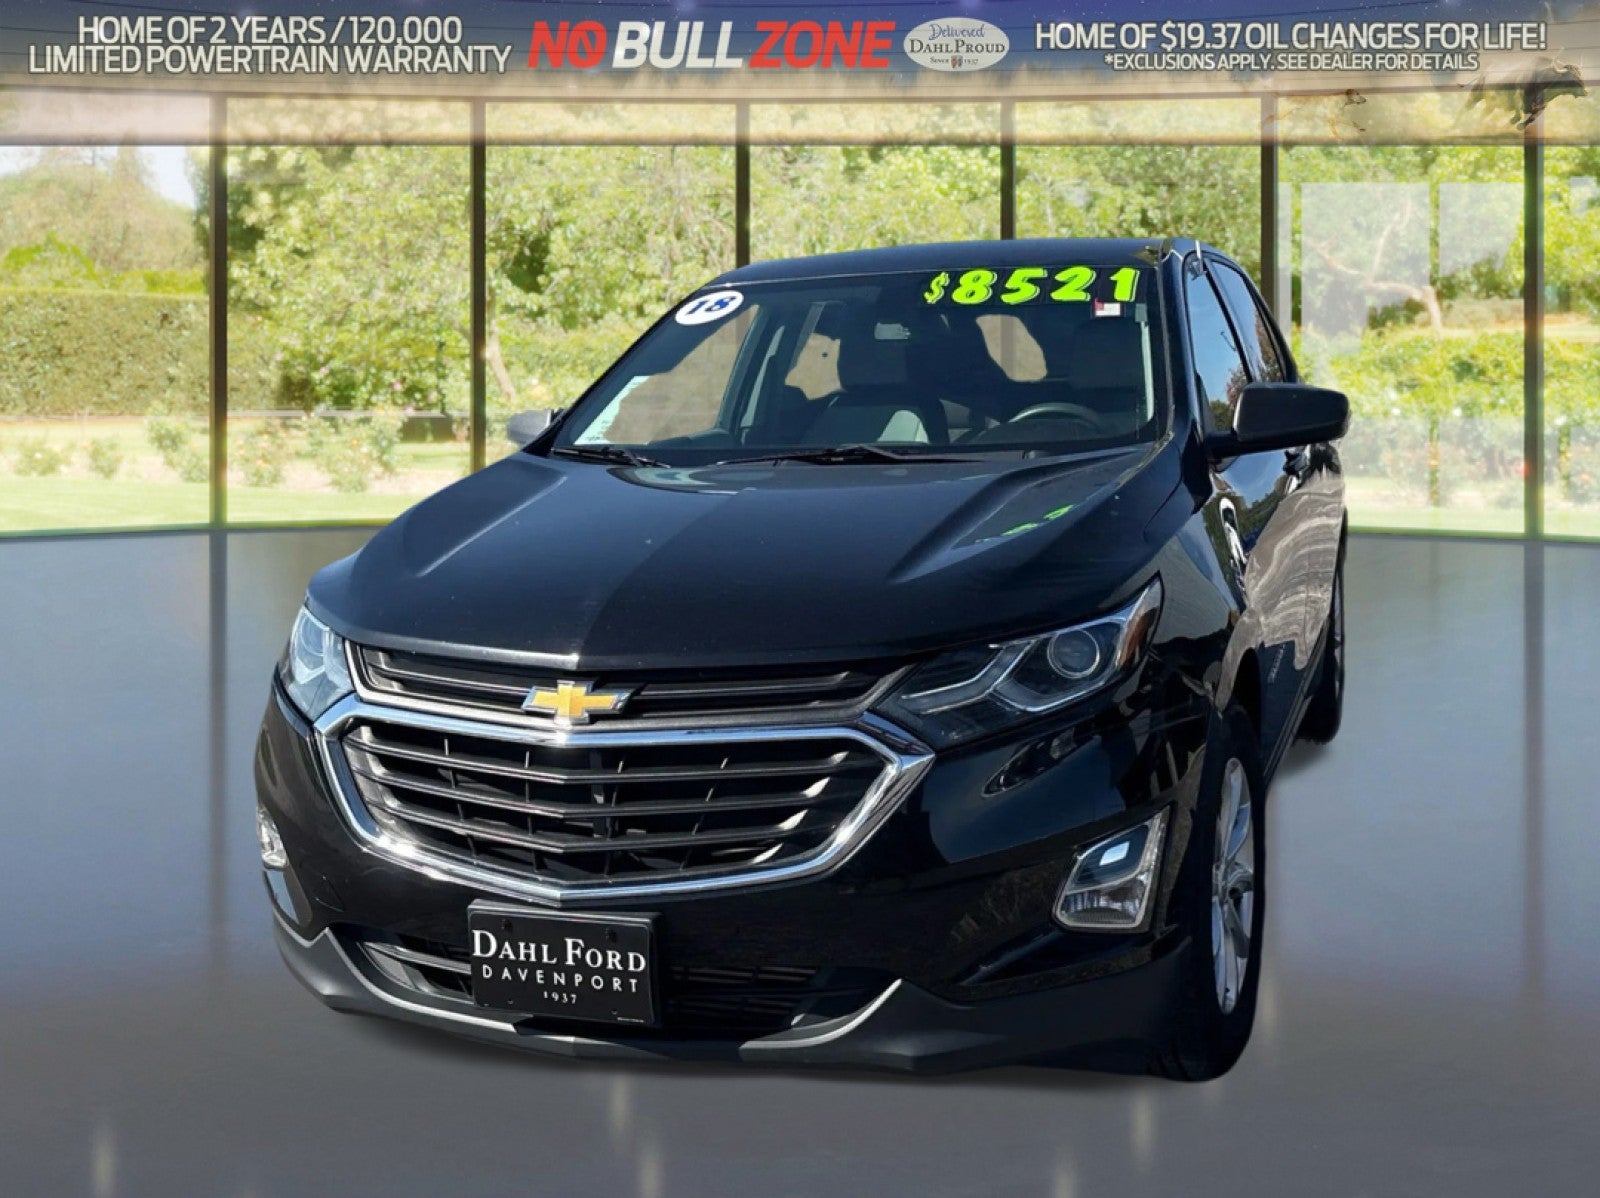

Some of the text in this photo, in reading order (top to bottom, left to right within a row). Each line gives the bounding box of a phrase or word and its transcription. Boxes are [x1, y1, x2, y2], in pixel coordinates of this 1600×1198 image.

[923, 265, 1140, 305] $8521
[471, 929, 647, 973] DAHL FORD
[482, 964, 638, 994] DAVENPORT
[543, 990, 578, 1005] 1937
